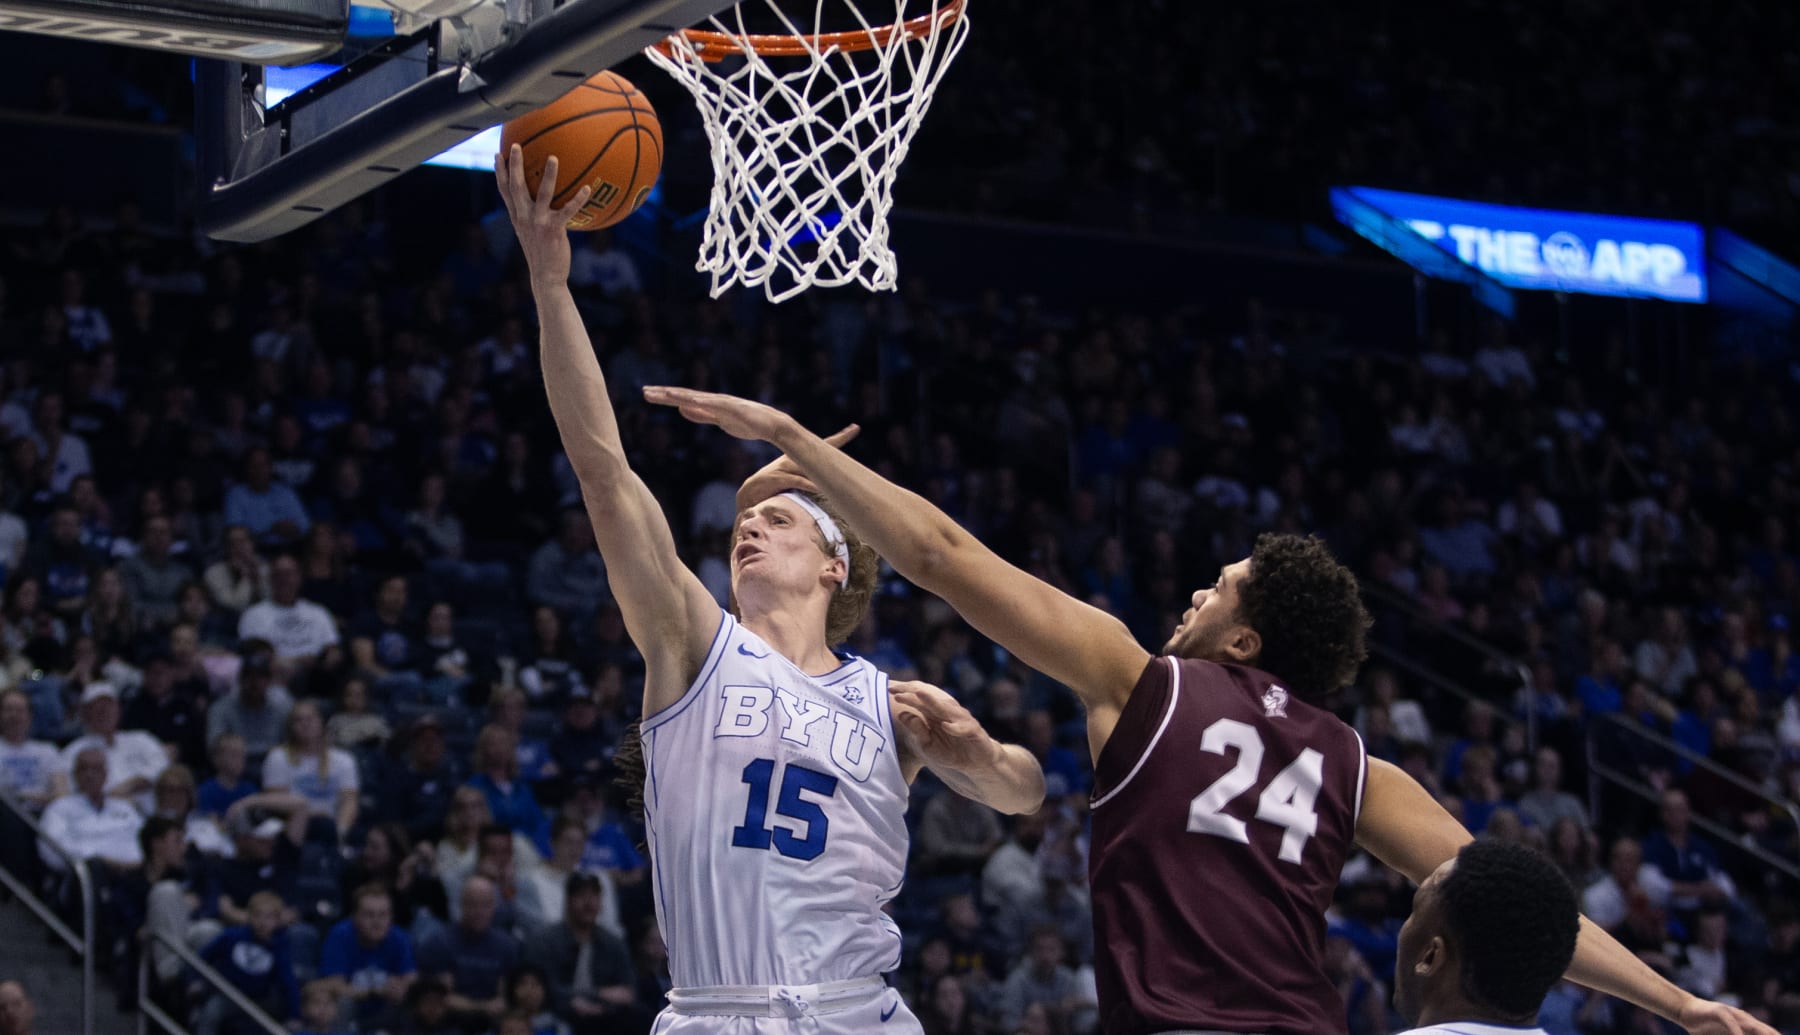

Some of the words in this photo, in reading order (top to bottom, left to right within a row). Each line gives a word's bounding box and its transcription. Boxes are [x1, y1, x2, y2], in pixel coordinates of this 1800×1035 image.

[1448, 223, 1541, 275] THE
[1591, 238, 1687, 286] APP
[713, 685, 886, 783] BYU
[732, 757, 839, 862] 15
[1186, 717, 1325, 866] 24
